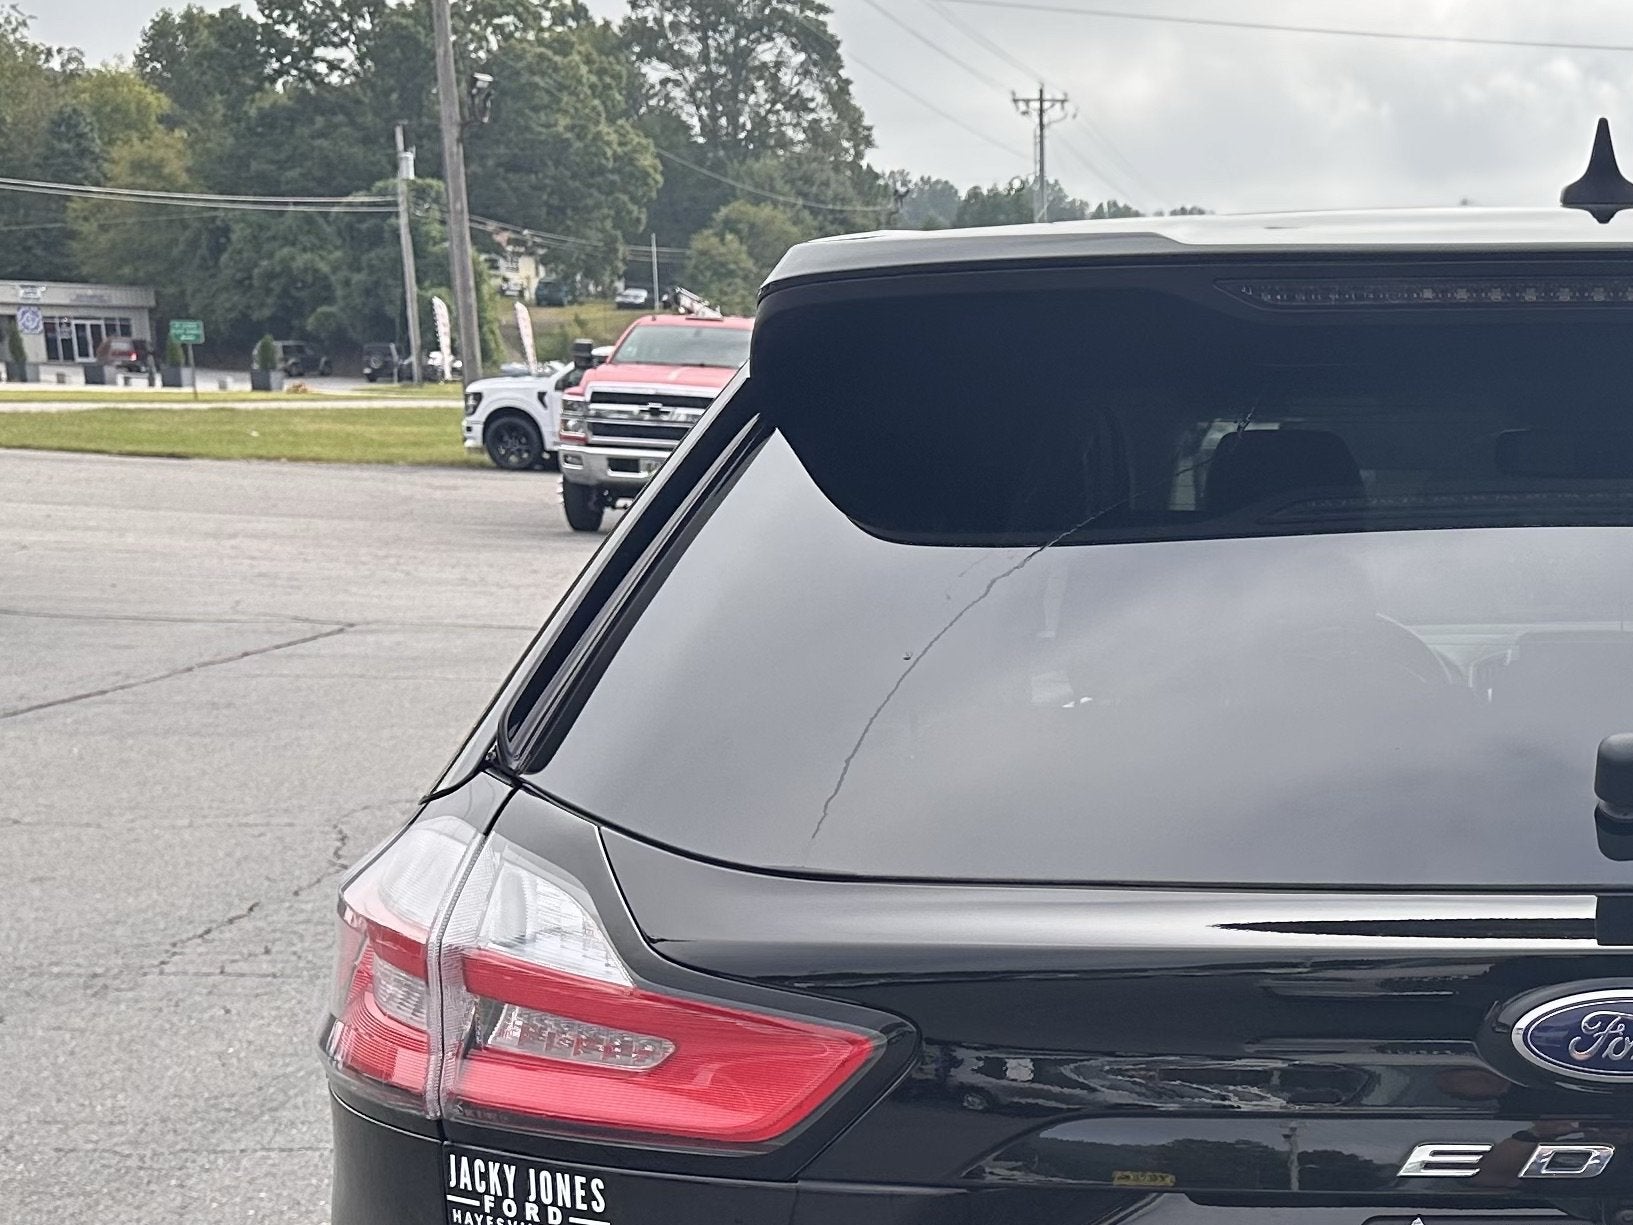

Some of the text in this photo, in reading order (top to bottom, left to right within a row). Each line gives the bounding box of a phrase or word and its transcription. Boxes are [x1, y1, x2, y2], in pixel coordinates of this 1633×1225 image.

[449, 1154, 606, 1213] JACKY JONES
[484, 1195, 563, 1225] FORD
